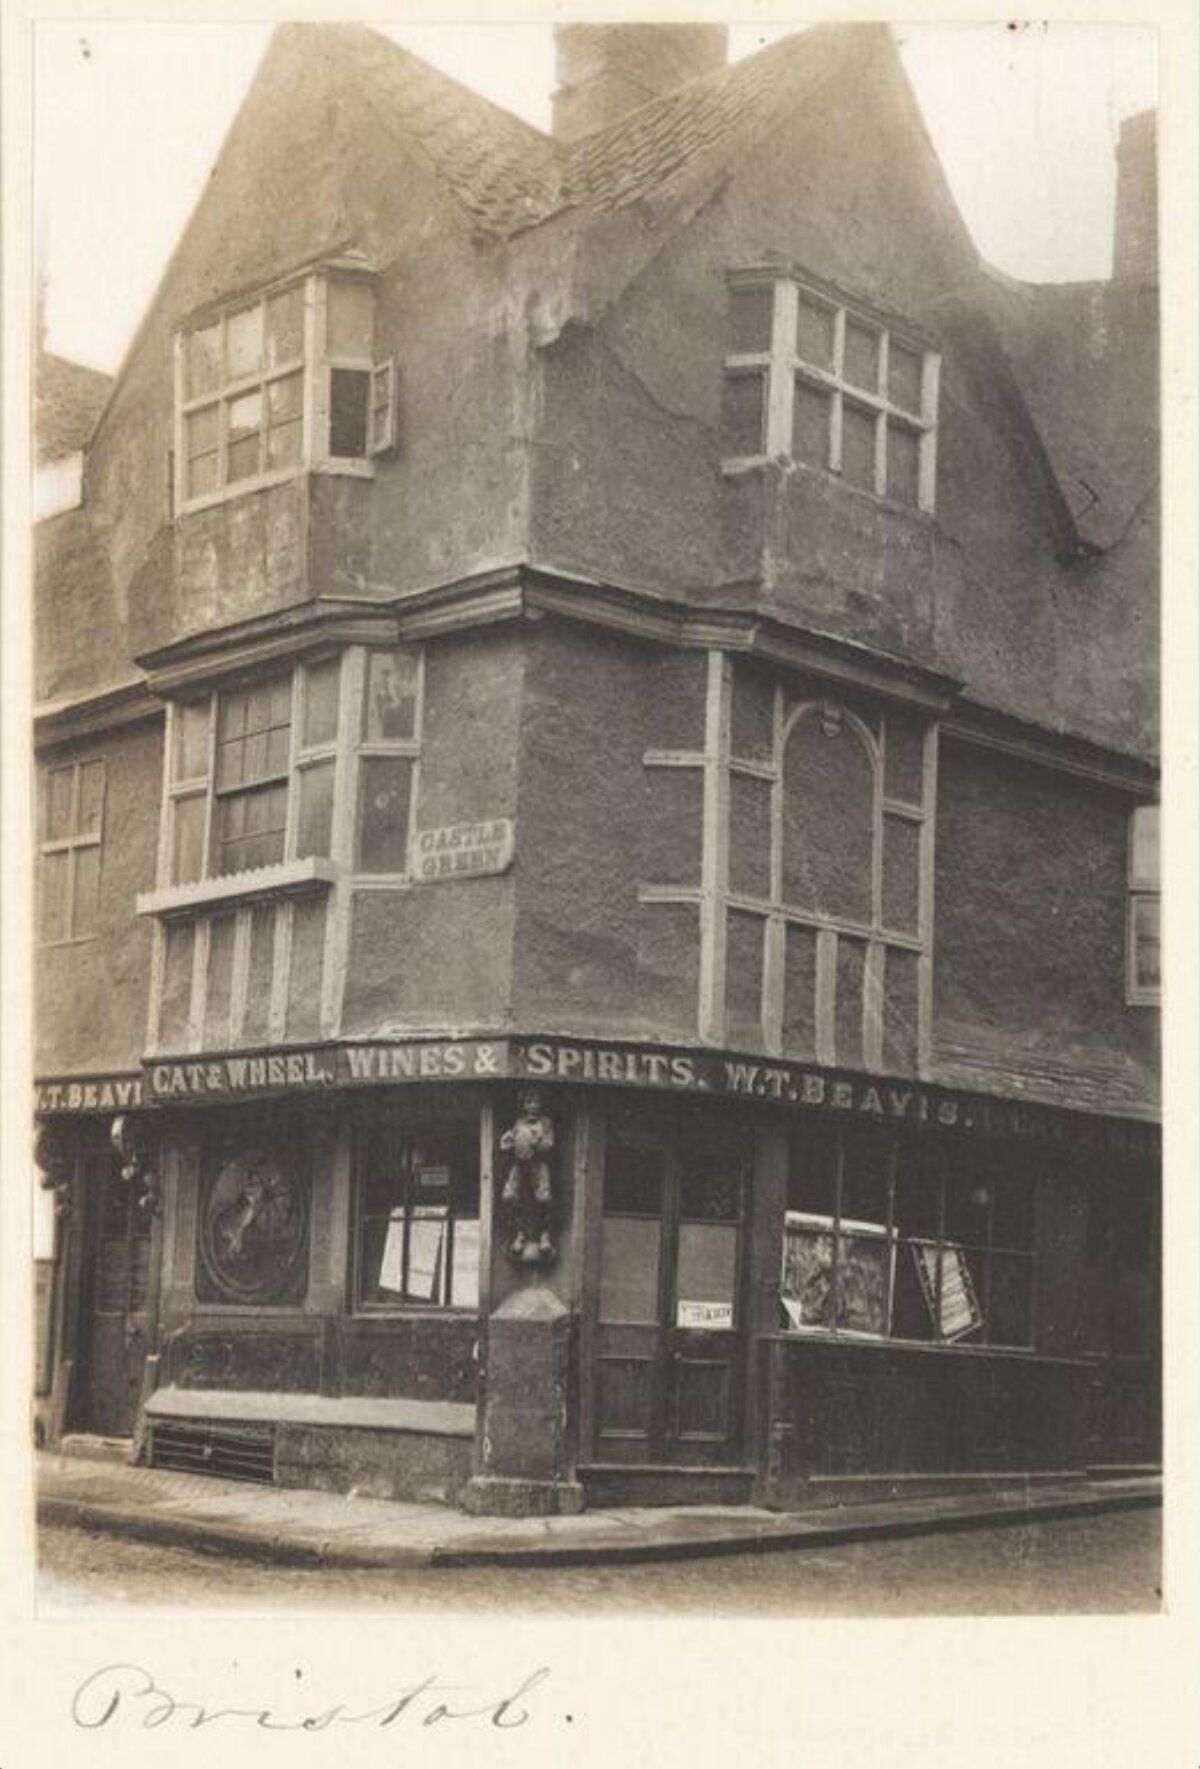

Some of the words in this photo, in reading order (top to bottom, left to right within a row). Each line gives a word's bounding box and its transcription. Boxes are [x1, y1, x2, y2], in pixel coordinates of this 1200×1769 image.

[420, 822, 506, 852] CASTLE
[422, 847, 501, 876] GREEN
[152, 1065, 204, 1095] CAT
[349, 1045, 464, 1079] WINES
[473, 1043, 501, 1075] &
